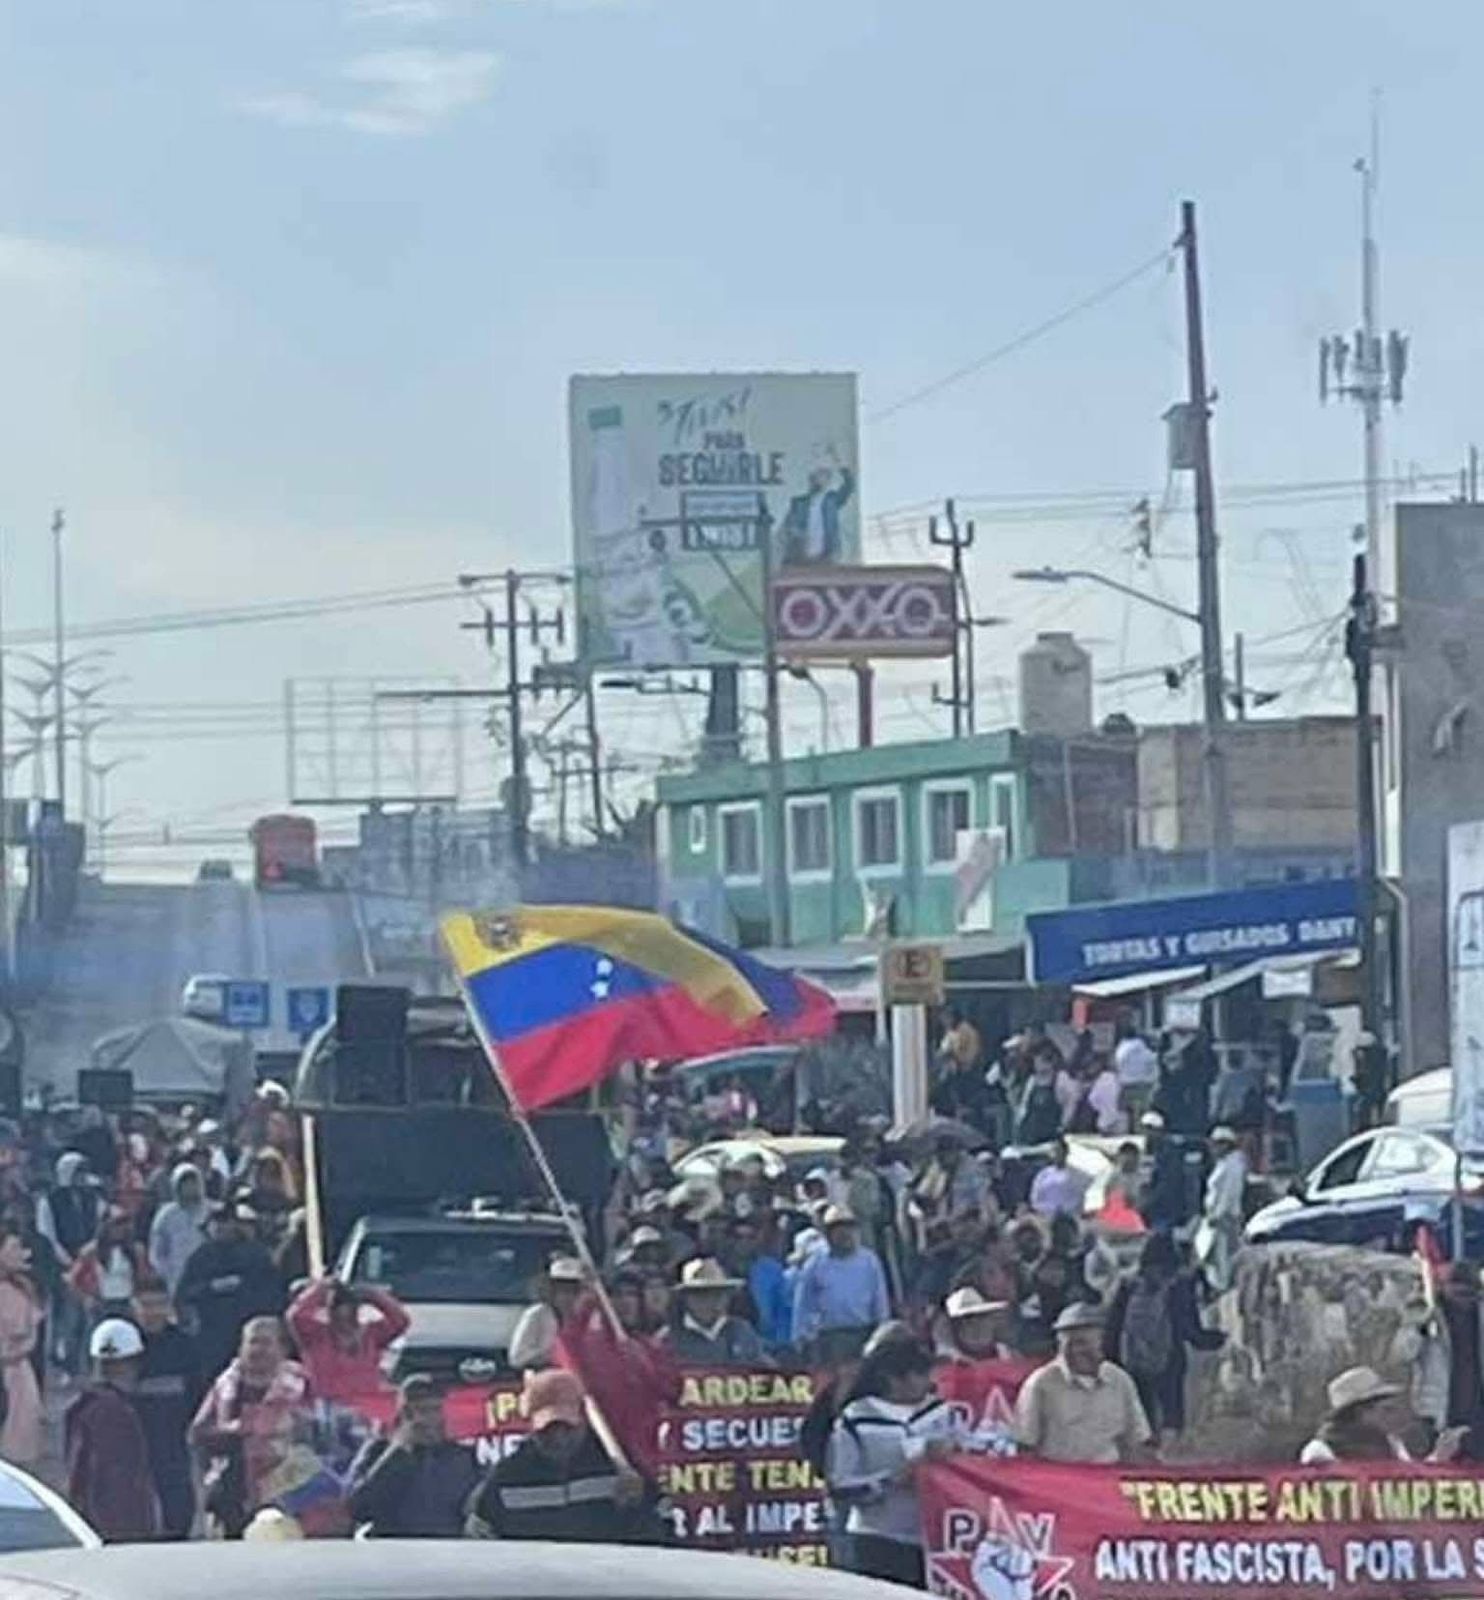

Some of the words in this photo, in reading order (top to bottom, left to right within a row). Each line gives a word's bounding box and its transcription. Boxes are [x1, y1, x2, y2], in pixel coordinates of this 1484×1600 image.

[782, 587, 938, 640] OXXO
[1163, 936, 1182, 957] Y
[747, 1459, 826, 1491] TEN
[696, 1505, 734, 1536] AL
[747, 1499, 834, 1533] IMPE
[1276, 1480, 1361, 1522] ANTI
[1095, 1539, 1168, 1583] ANTI
[1176, 1539, 1336, 1591] FASCISTA,
[1345, 1539, 1416, 1582] POR
[1422, 1537, 1467, 1580] LA
